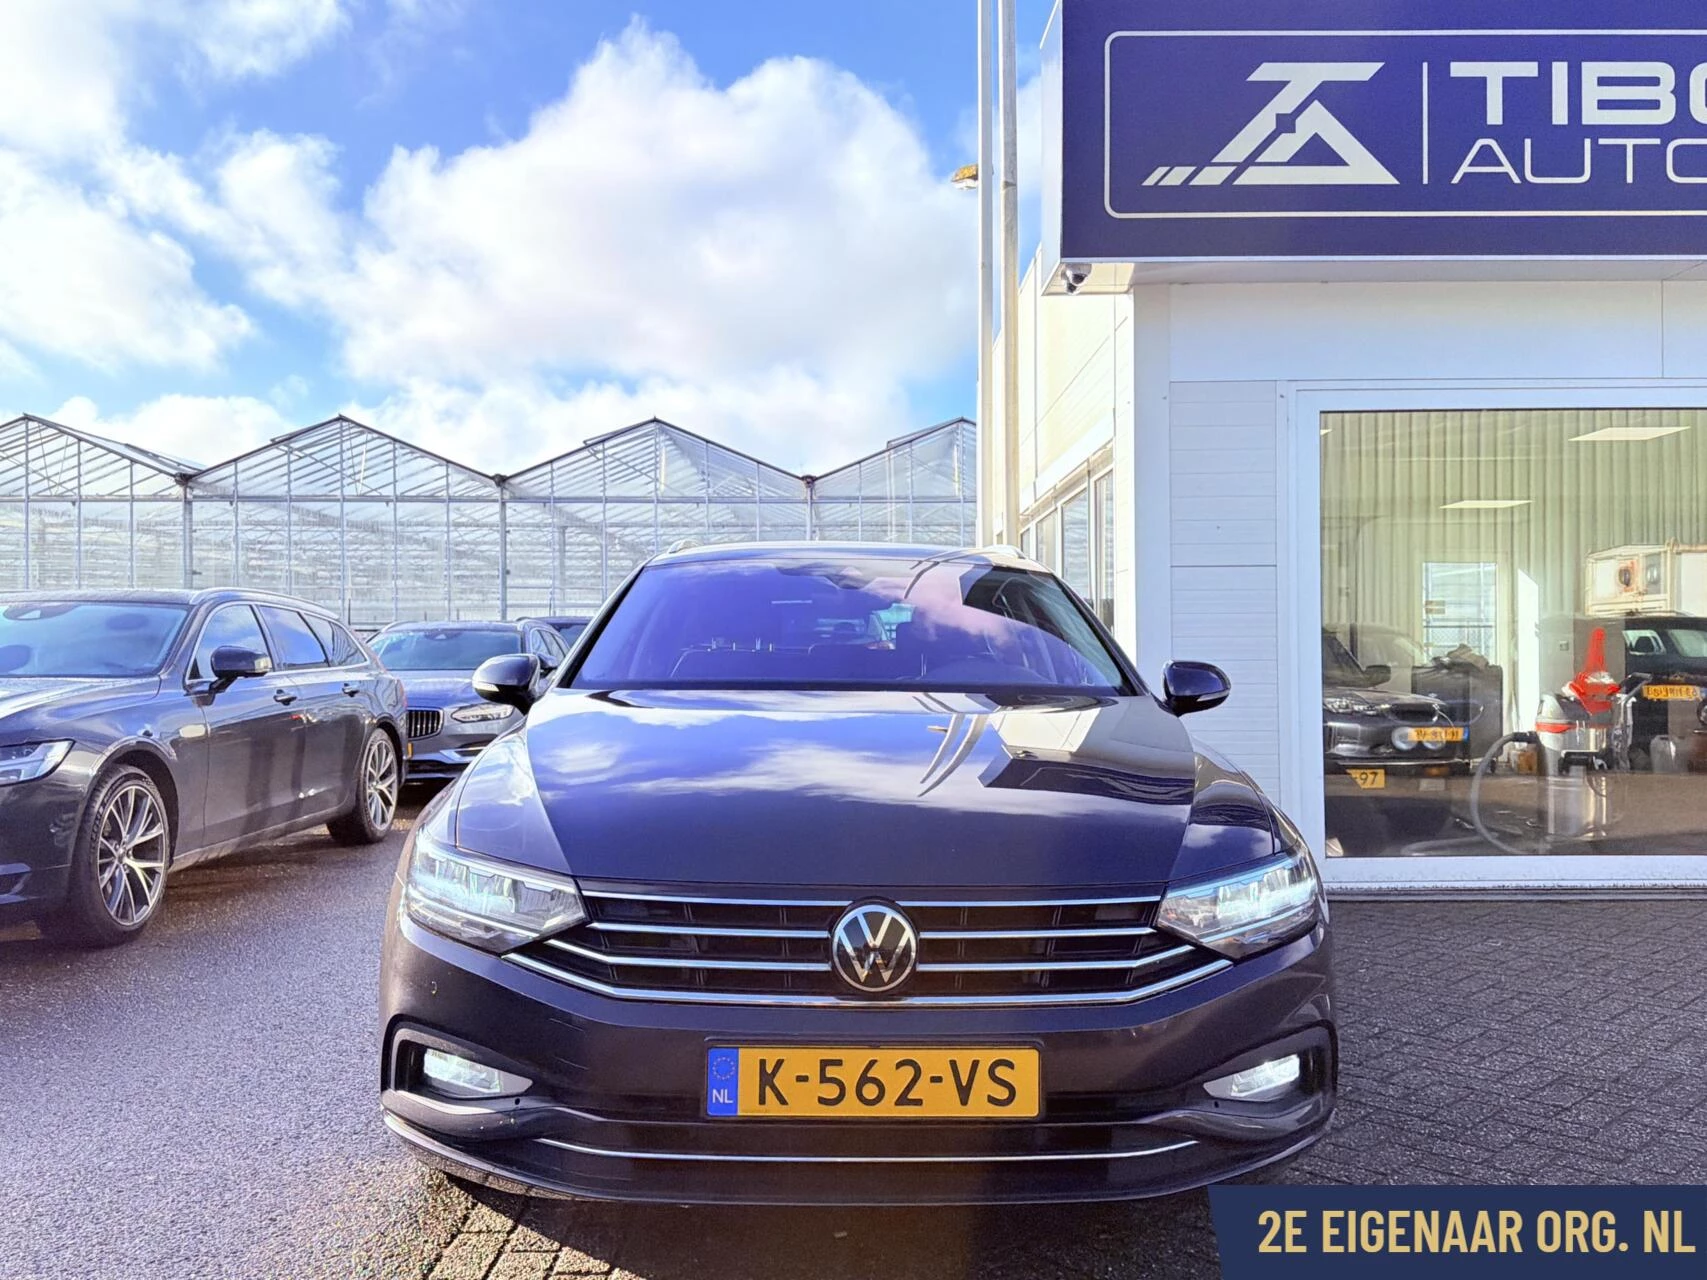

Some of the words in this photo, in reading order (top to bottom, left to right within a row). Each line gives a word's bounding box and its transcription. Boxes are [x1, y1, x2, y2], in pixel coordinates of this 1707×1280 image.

[1450, 61, 1707, 125] TIB
[712, 1088, 734, 1104] NL
[758, 1058, 1017, 1107] K-562-VS
